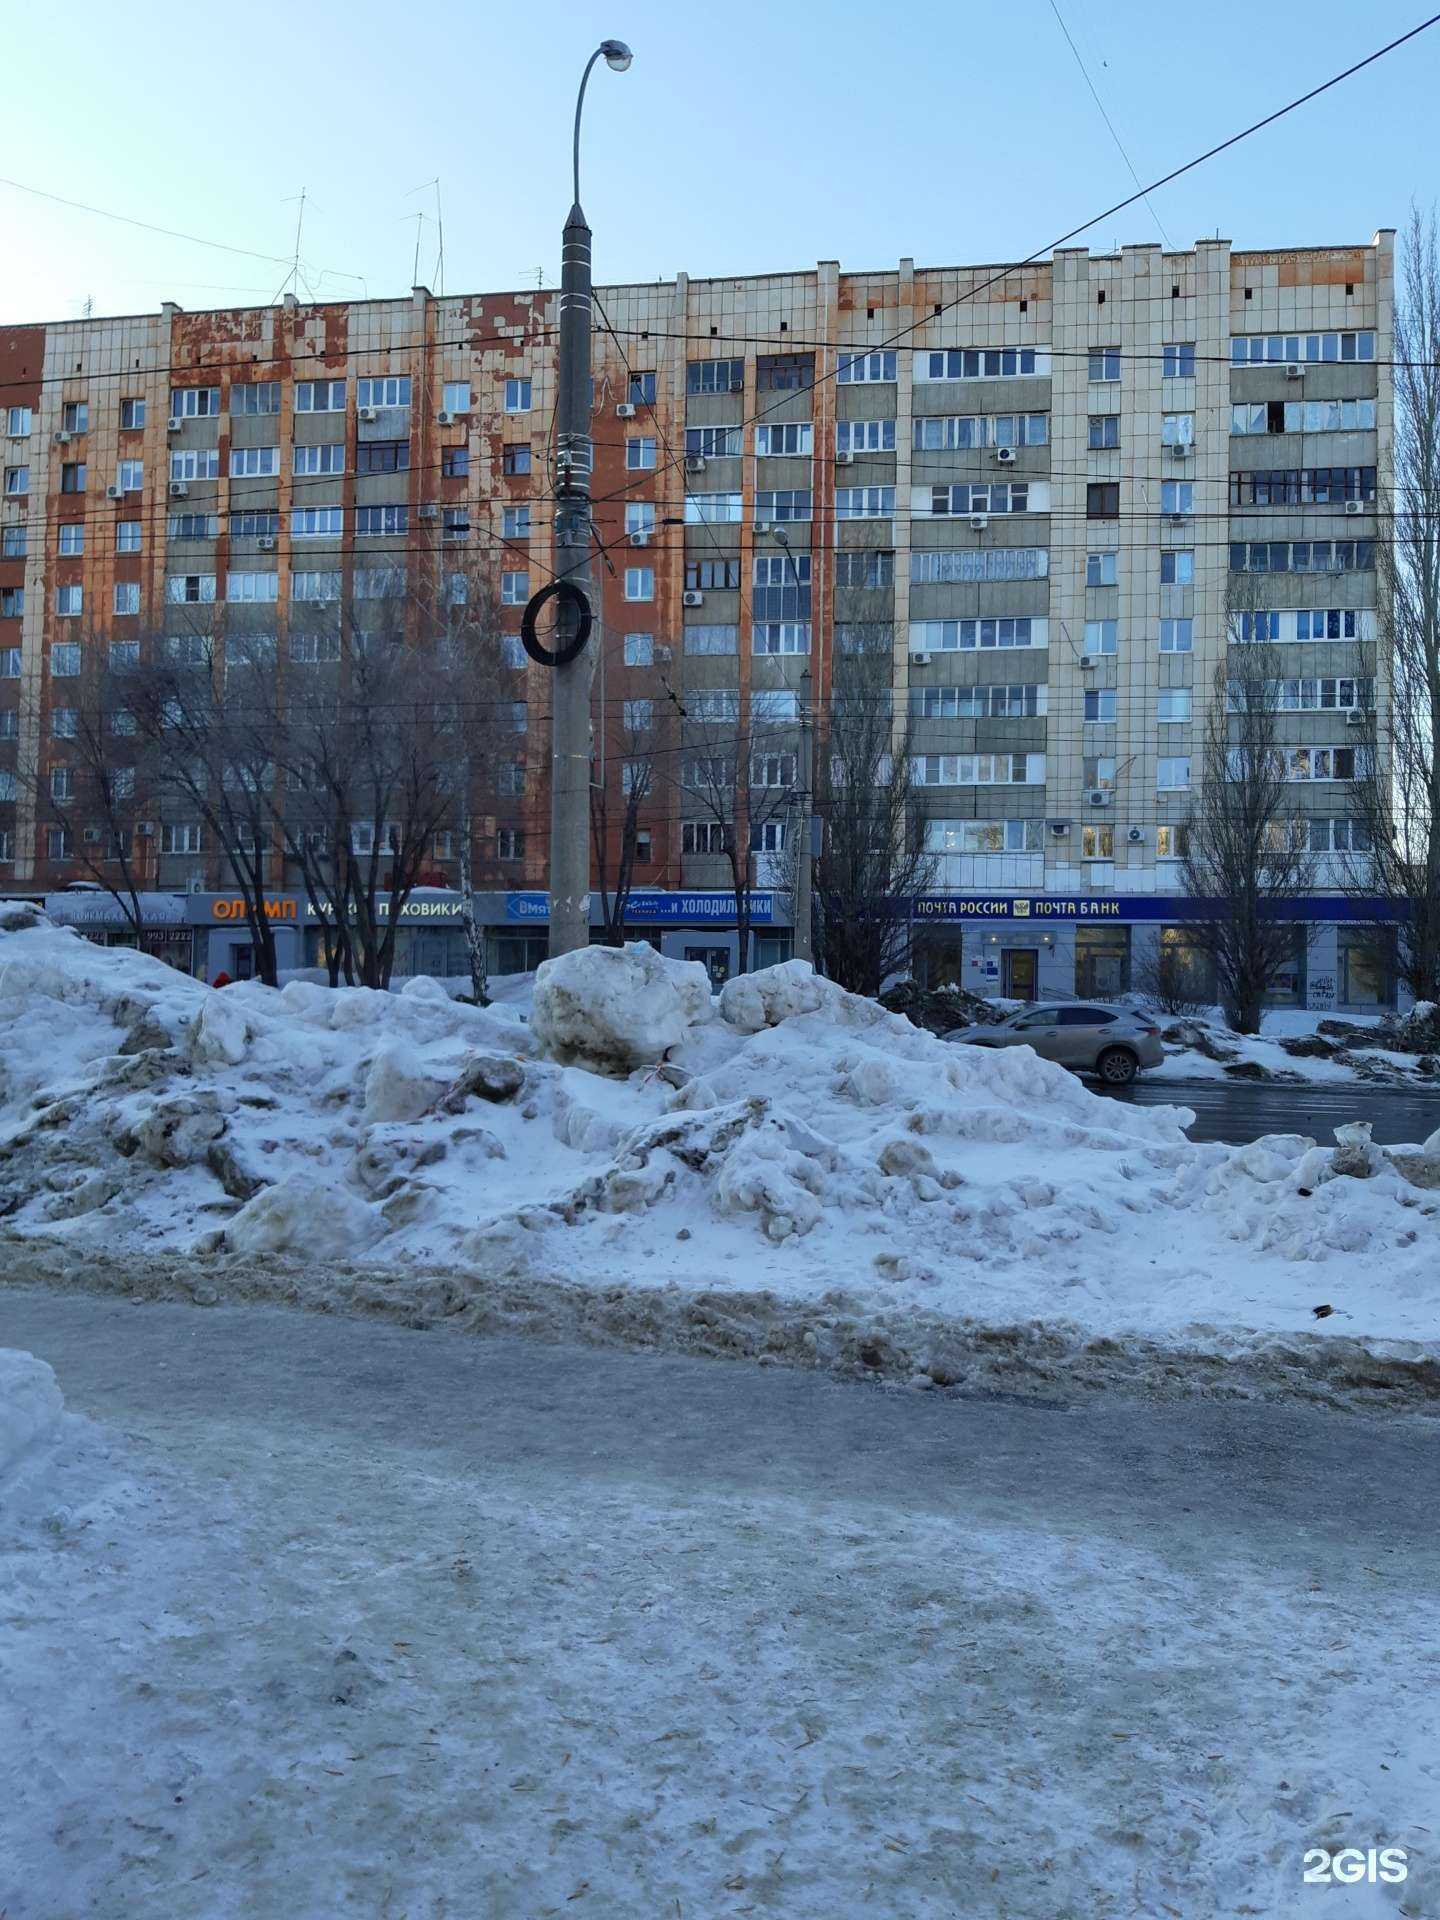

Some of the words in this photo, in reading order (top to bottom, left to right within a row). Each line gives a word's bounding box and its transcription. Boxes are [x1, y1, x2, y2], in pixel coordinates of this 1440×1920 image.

[213, 898, 297, 919] ОЛМП
[378, 903, 462, 916] ПХОВИКИ
[681, 899, 771, 916] ХОЛОДИЛНИКИ
[917, 901, 957, 914] ПОЧТА
[959, 901, 1008, 914] РОССИИ
[1035, 901, 1077, 914] ПОЧТА
[1080, 901, 1120, 914] БАНК
